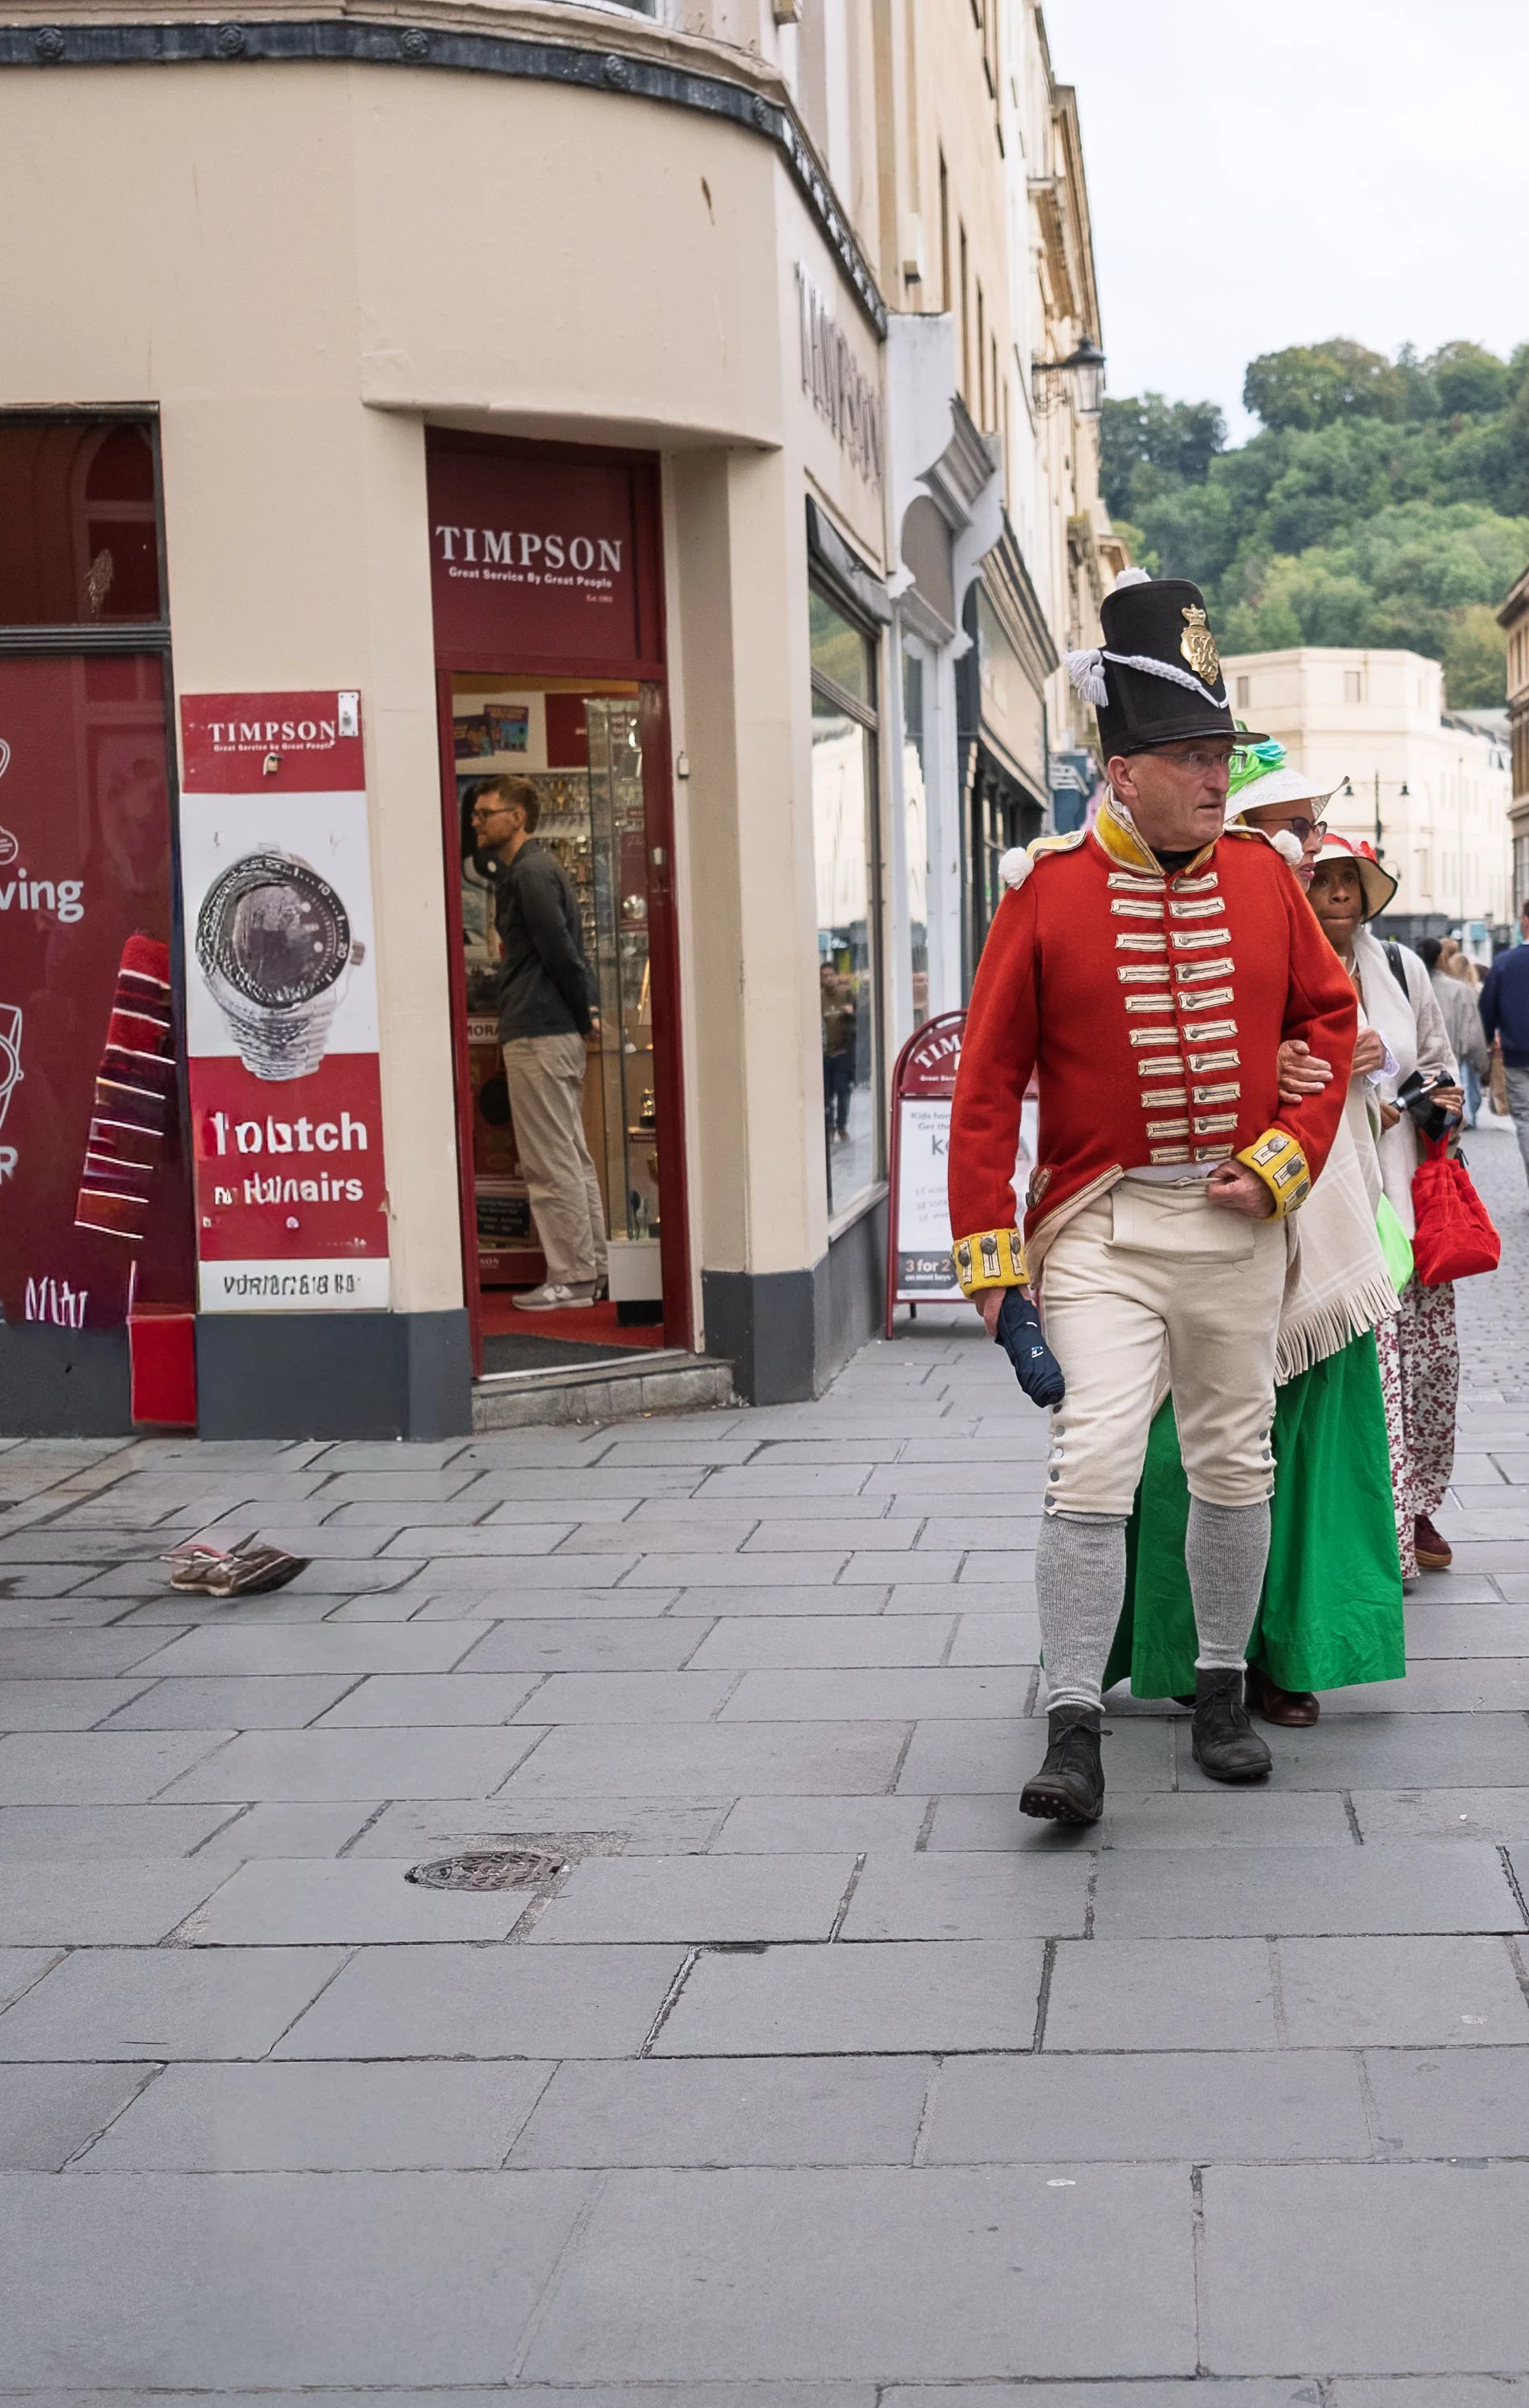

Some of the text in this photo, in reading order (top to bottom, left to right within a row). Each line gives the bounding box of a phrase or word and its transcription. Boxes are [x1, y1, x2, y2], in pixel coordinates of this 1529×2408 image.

[435, 525, 623, 572] TIMPSON
[449, 566, 612, 590] Great Service By Great People
[207, 720, 335, 743] TIMPSON
[213, 744, 236, 752] Great
[238, 743, 268, 751] Service
[282, 742, 304, 750] Great
[905, 1258, 950, 1273] 3 for 2
[916, 1273, 934, 1282] most
